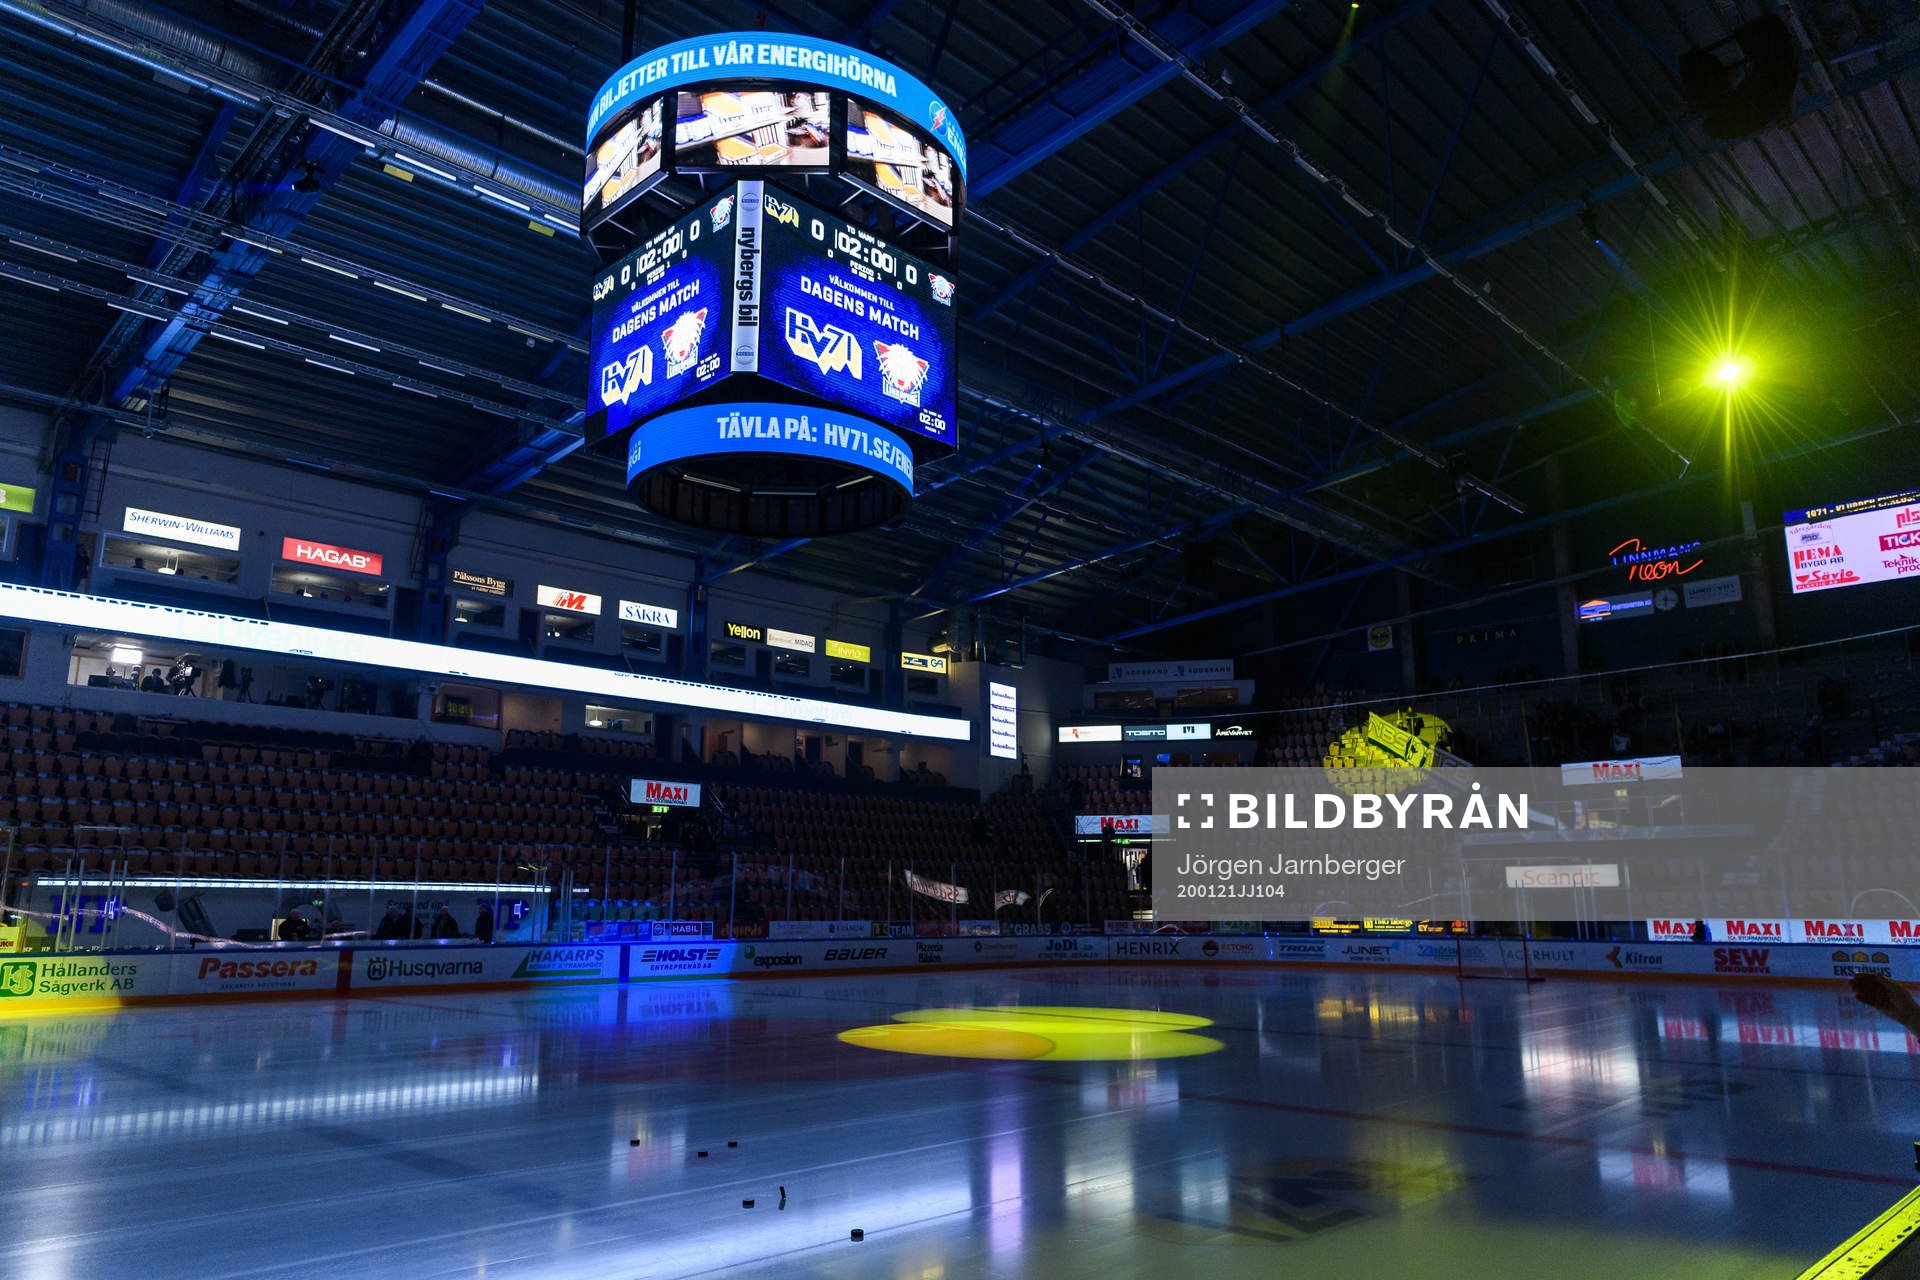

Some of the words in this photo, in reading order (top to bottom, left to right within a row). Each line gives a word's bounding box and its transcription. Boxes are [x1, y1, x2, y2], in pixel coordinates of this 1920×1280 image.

[600, 58, 669, 117] BILJETTER
[671, 47, 710, 74] TILL
[713, 40, 754, 66] VÅR
[758, 44, 897, 97] ENERGIHÖRNA
[690, 219, 701, 242] 0
[811, 218, 825, 241] 0
[638, 232, 681, 275] 02:00
[827, 249, 834, 259] 0
[838, 231, 894, 274] 02:00
[735, 226, 761, 302] nybergs
[620, 264, 631, 286] 0
[905, 264, 918, 285] 0
[828, 274, 878, 303] VÄLKOMMEN
[878, 296, 895, 311] TILL
[896, 281, 903, 290] 0
[612, 306, 656, 344] DAGENS
[659, 279, 700, 316] MATCH
[737, 304, 759, 327] bil
[800, 275, 865, 317] DAGENS
[869, 305, 920, 341] MATCH
[785, 306, 863, 380] HV71
[696, 357, 720, 378] 02:00
[716, 412, 781, 440] TÄVLA
[784, 415, 818, 442] PÅ:
[919, 412, 946, 431] 02:00
[1794, 545, 1842, 570] HEMA
[1800, 557, 1827, 569] BYGG
[1830, 556, 1844, 564] AB
[1881, 556, 1918, 569] Teknik
[453, 570, 486, 584] Pålssons
[487, 576, 506, 589] Bygg
[625, 604, 670, 625] SÄKRA
[728, 623, 761, 641] Yellon
[645, 782, 689, 801] MAXI
[1101, 817, 1139, 830] MAXI
[1523, 868, 1601, 886] Scandic
[1653, 921, 1697, 935] MAX
[1726, 920, 1781, 936] MAXI
[1805, 920, 1865, 937] MAXI
[655, 949, 707, 962] HOLST
[1116, 942, 1180, 955] HENRIX
[1279, 945, 1324, 953] TROAX
[1342, 946, 1392, 955] JUNET
[1713, 947, 1770, 967] SEW
[754, 952, 802, 969] exposion
[1625, 952, 1663, 965] Kitron
[42, 961, 137, 977] Hållanders
[197, 957, 319, 980] Passera
[388, 960, 483, 978] Husqvarna
[39, 979, 105, 995] Sågverk
[110, 979, 135, 990] AB
